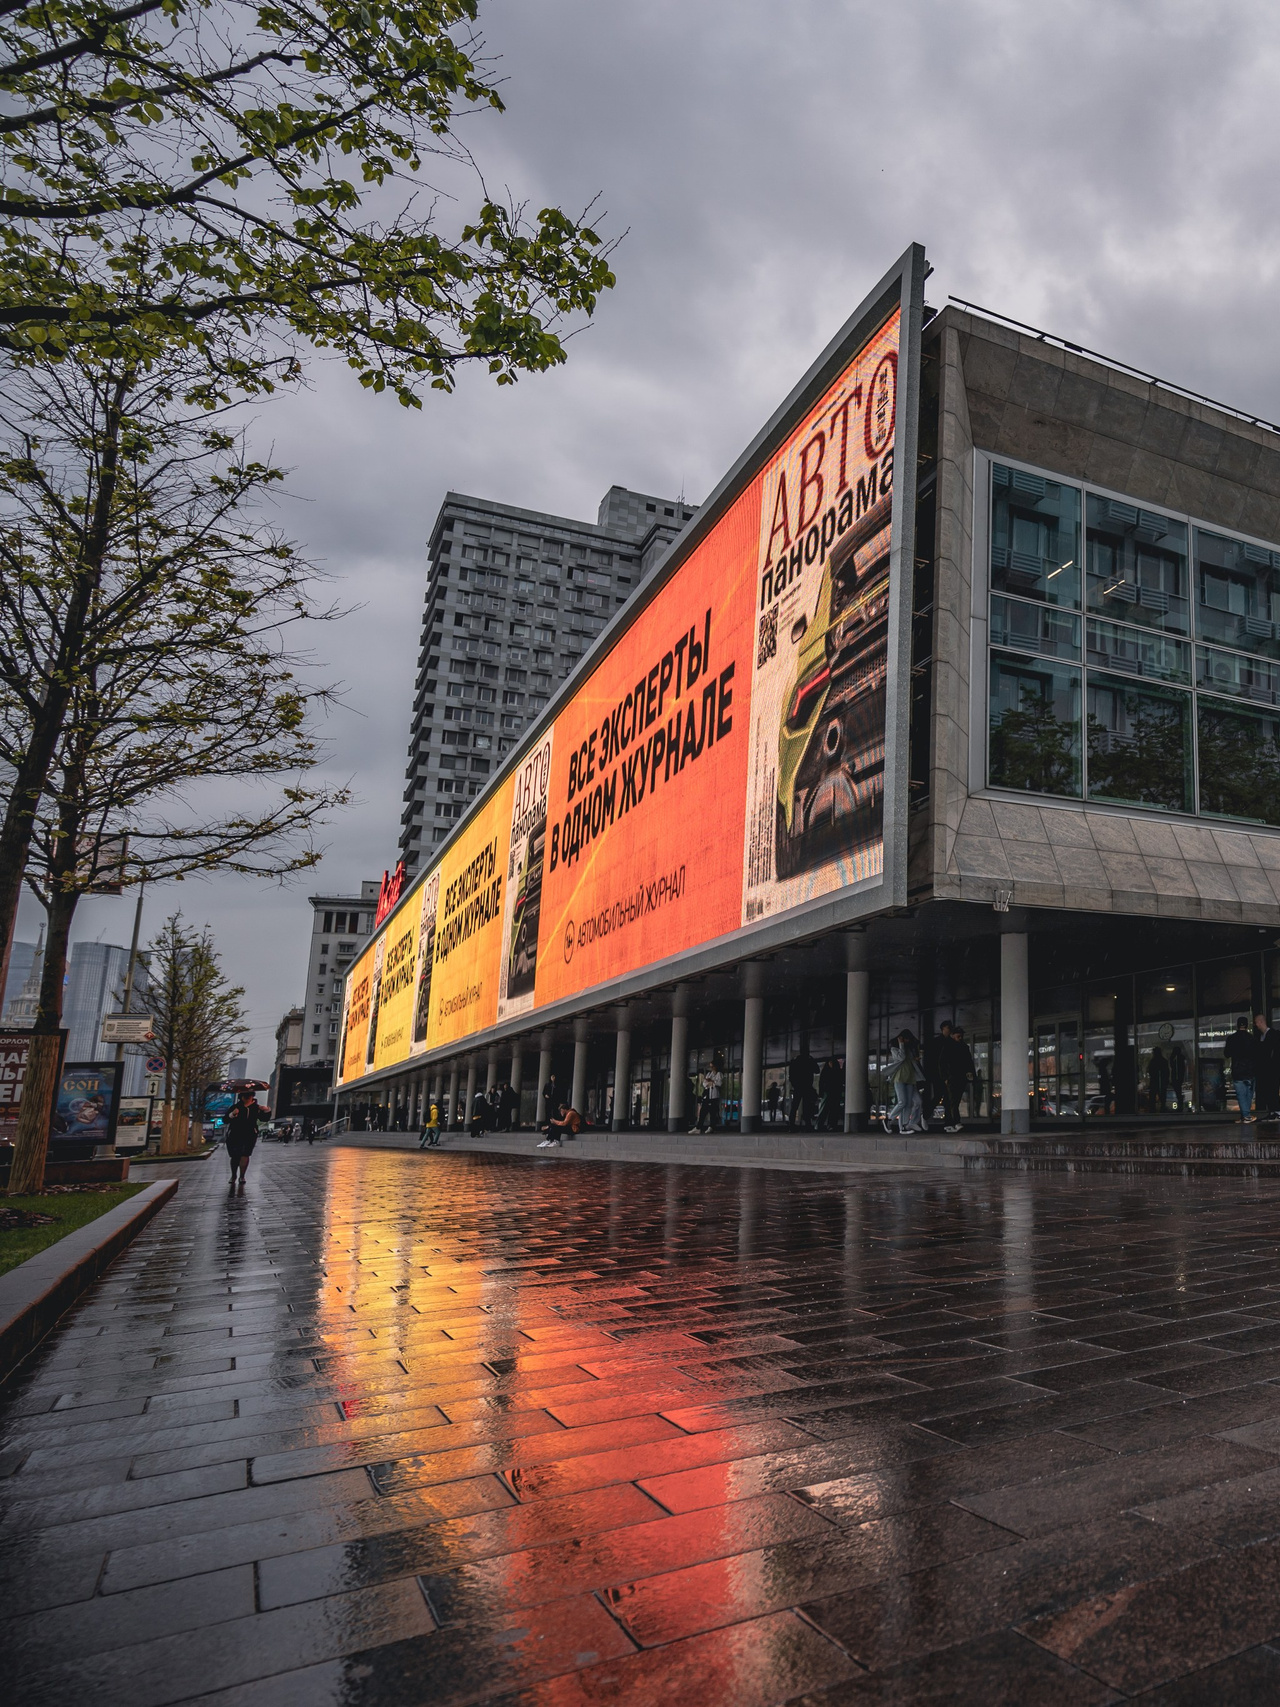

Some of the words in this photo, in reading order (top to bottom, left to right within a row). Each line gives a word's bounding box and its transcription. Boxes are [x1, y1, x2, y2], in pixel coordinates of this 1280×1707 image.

[763, 350, 898, 573] АВТО
[760, 446, 894, 612] панорама
[567, 727, 598, 803] ВСЕ
[598, 608, 712, 762] ЭКСПЕРТЫ
[512, 741, 551, 827] АВТО
[549, 821, 559, 873] В
[561, 778, 618, 869] ОДНОМ
[618, 661, 735, 819] ЖУРНАЛЕ
[510, 794, 547, 849] панорама
[440, 911, 464, 964] ОДНОМ
[462, 874, 502, 943] ЖУРНАЛЕ
[444, 878, 458, 921] ВСЕ
[457, 836, 498, 909] ЭКСПЕРТЫ
[577, 884, 645, 950] АВТОМОБИЛЬНЫЙ
[645, 864, 686, 915] ЖУРНАЛ
[63, 1080, 100, 1091] СОН
